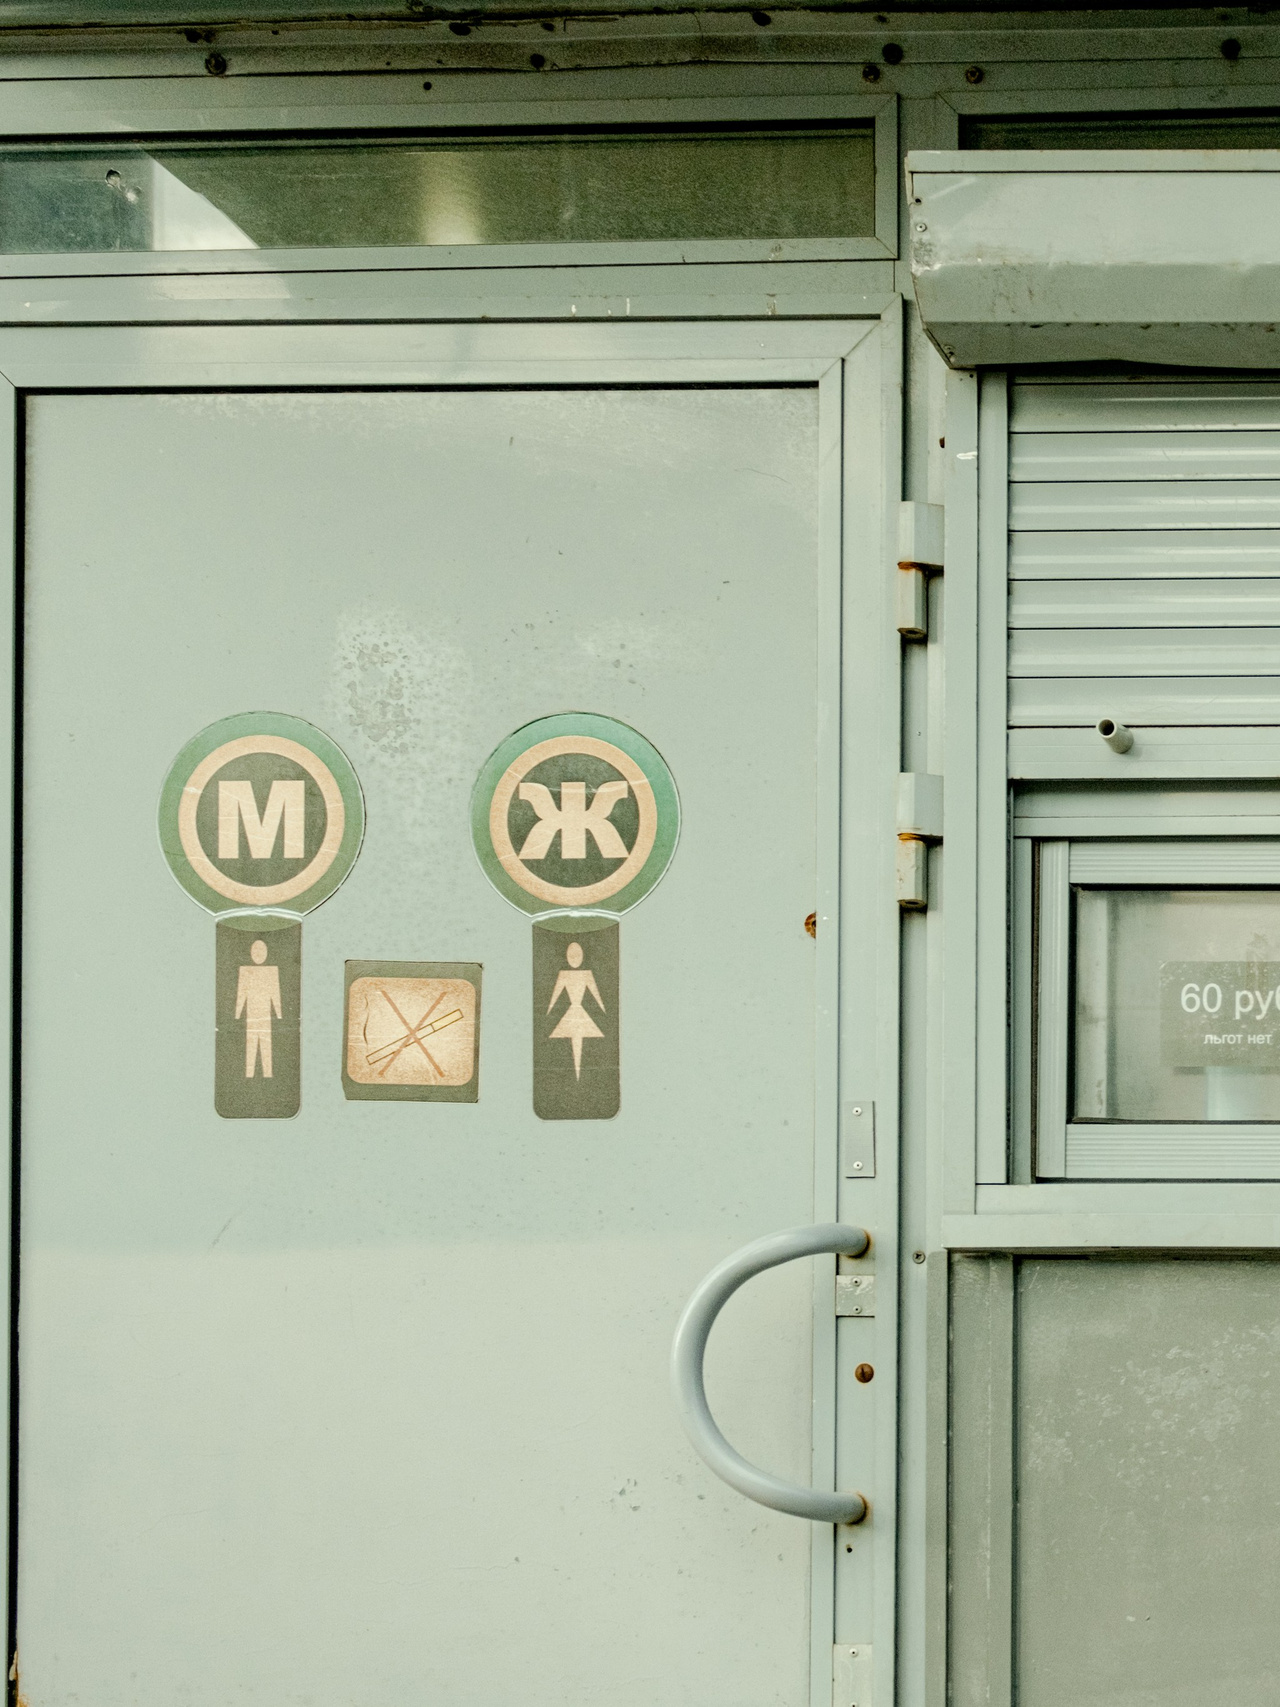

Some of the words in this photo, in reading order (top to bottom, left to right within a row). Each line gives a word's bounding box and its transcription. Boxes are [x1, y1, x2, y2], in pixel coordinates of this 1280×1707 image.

[218, 780, 305, 859] М
[518, 781, 629, 860] Ж
[1180, 983, 1222, 1013] 60
[1203, 1033, 1243, 1045] льгот
[1247, 1033, 1273, 1045] нет
